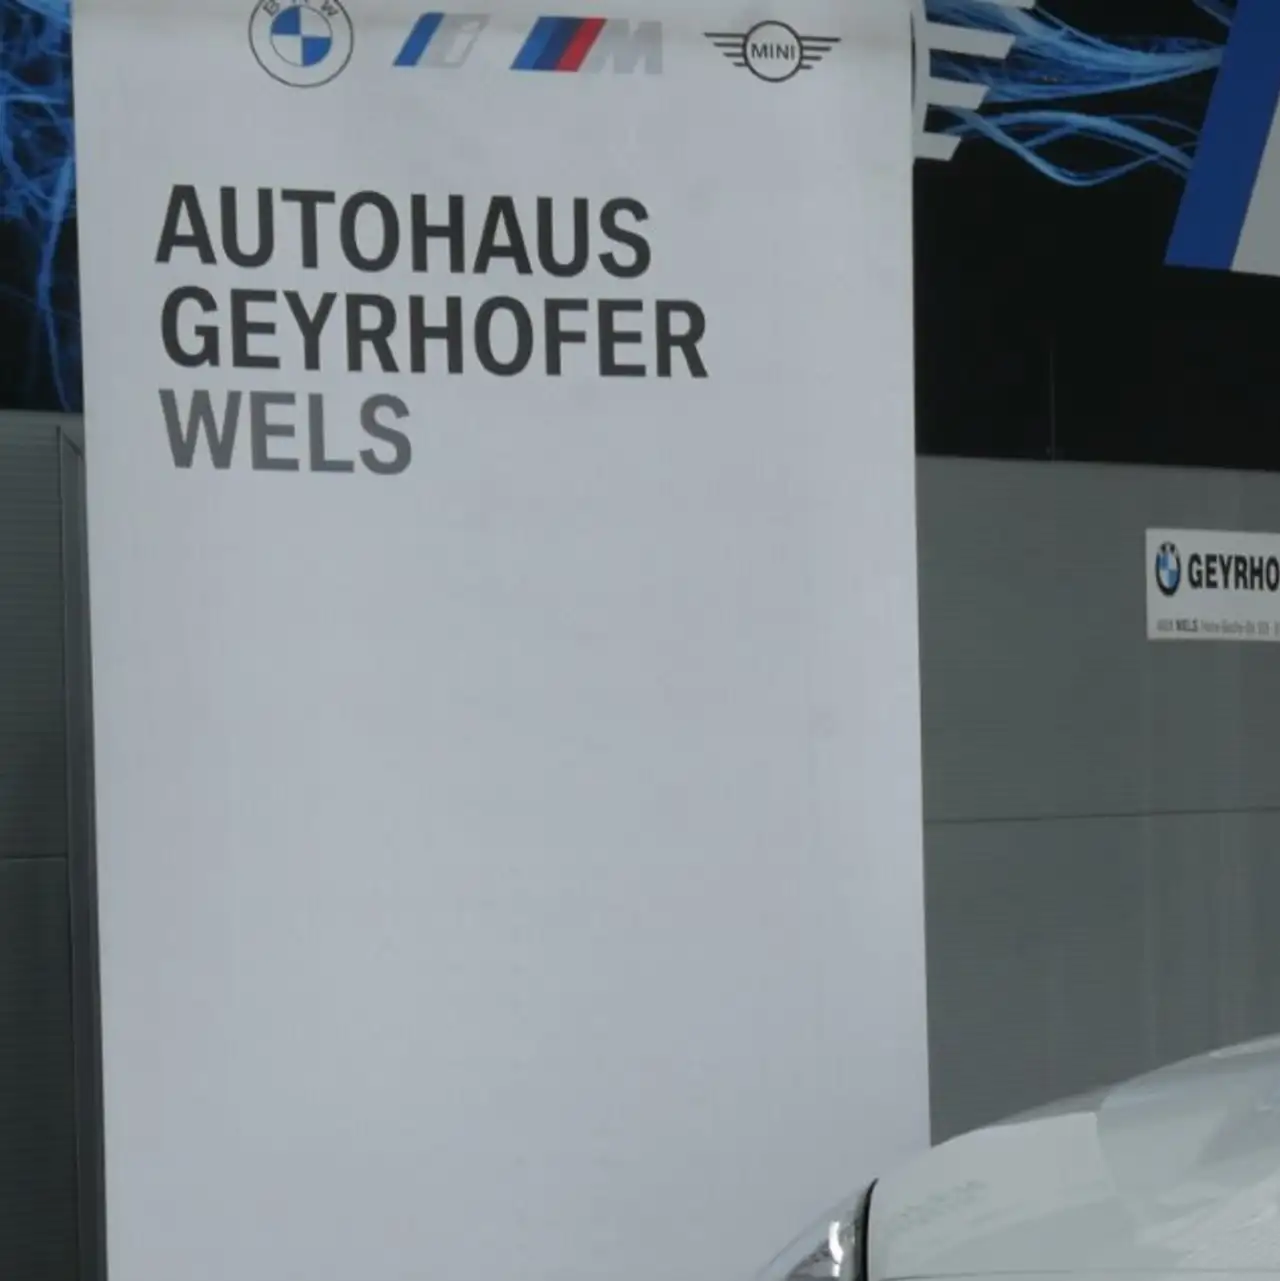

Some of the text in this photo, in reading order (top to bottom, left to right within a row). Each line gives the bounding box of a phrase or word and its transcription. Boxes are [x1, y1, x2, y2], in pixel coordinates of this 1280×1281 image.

[262, 0, 339, 17] BW
[750, 43, 795, 60] MINI
[155, 184, 651, 279] AUTOHAUS
[160, 285, 709, 379] GEYRHOFER
[158, 389, 412, 475] WELS
